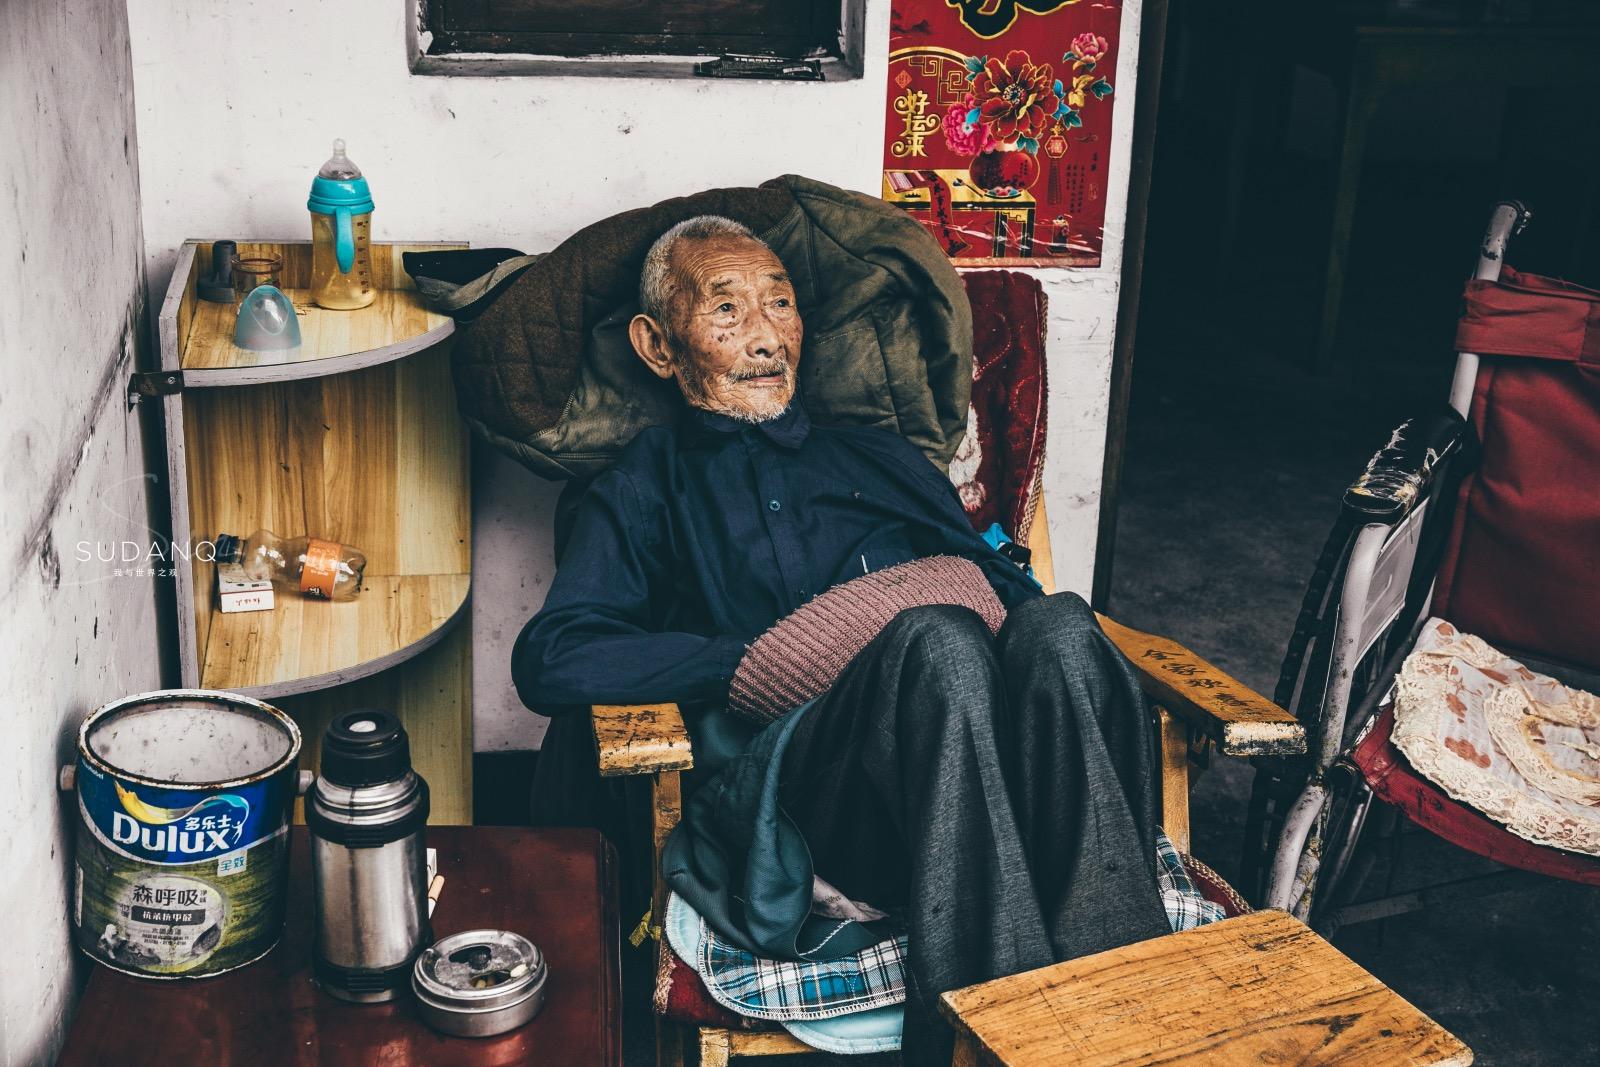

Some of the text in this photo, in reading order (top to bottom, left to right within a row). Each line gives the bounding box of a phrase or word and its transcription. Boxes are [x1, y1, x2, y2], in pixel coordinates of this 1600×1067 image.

[112, 811, 231, 854] Dulux
[184, 814, 232, 831] 多乐士
[133, 884, 200, 906] 森呼吸
